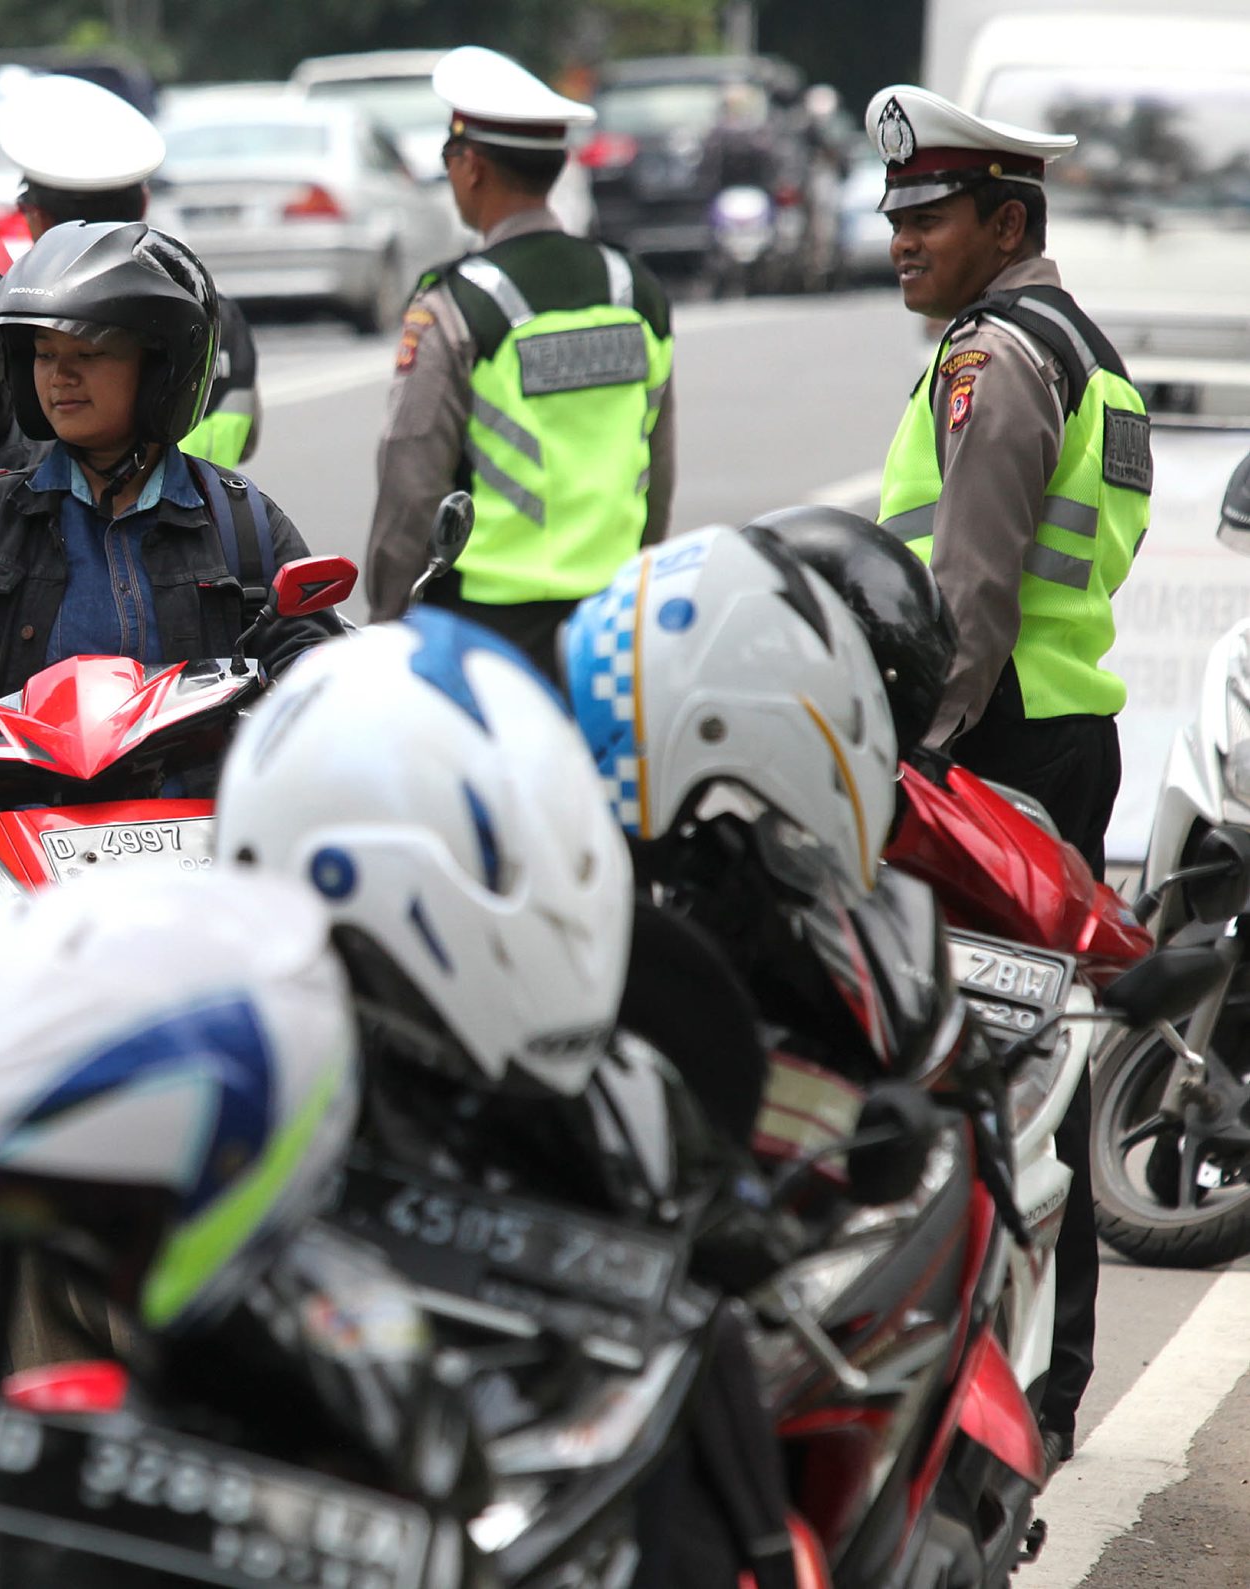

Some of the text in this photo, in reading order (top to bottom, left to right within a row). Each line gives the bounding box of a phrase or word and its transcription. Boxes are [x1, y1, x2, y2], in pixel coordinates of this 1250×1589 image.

[49, 825, 182, 860] D 4997
[965, 953, 1054, 1000] ZBW
